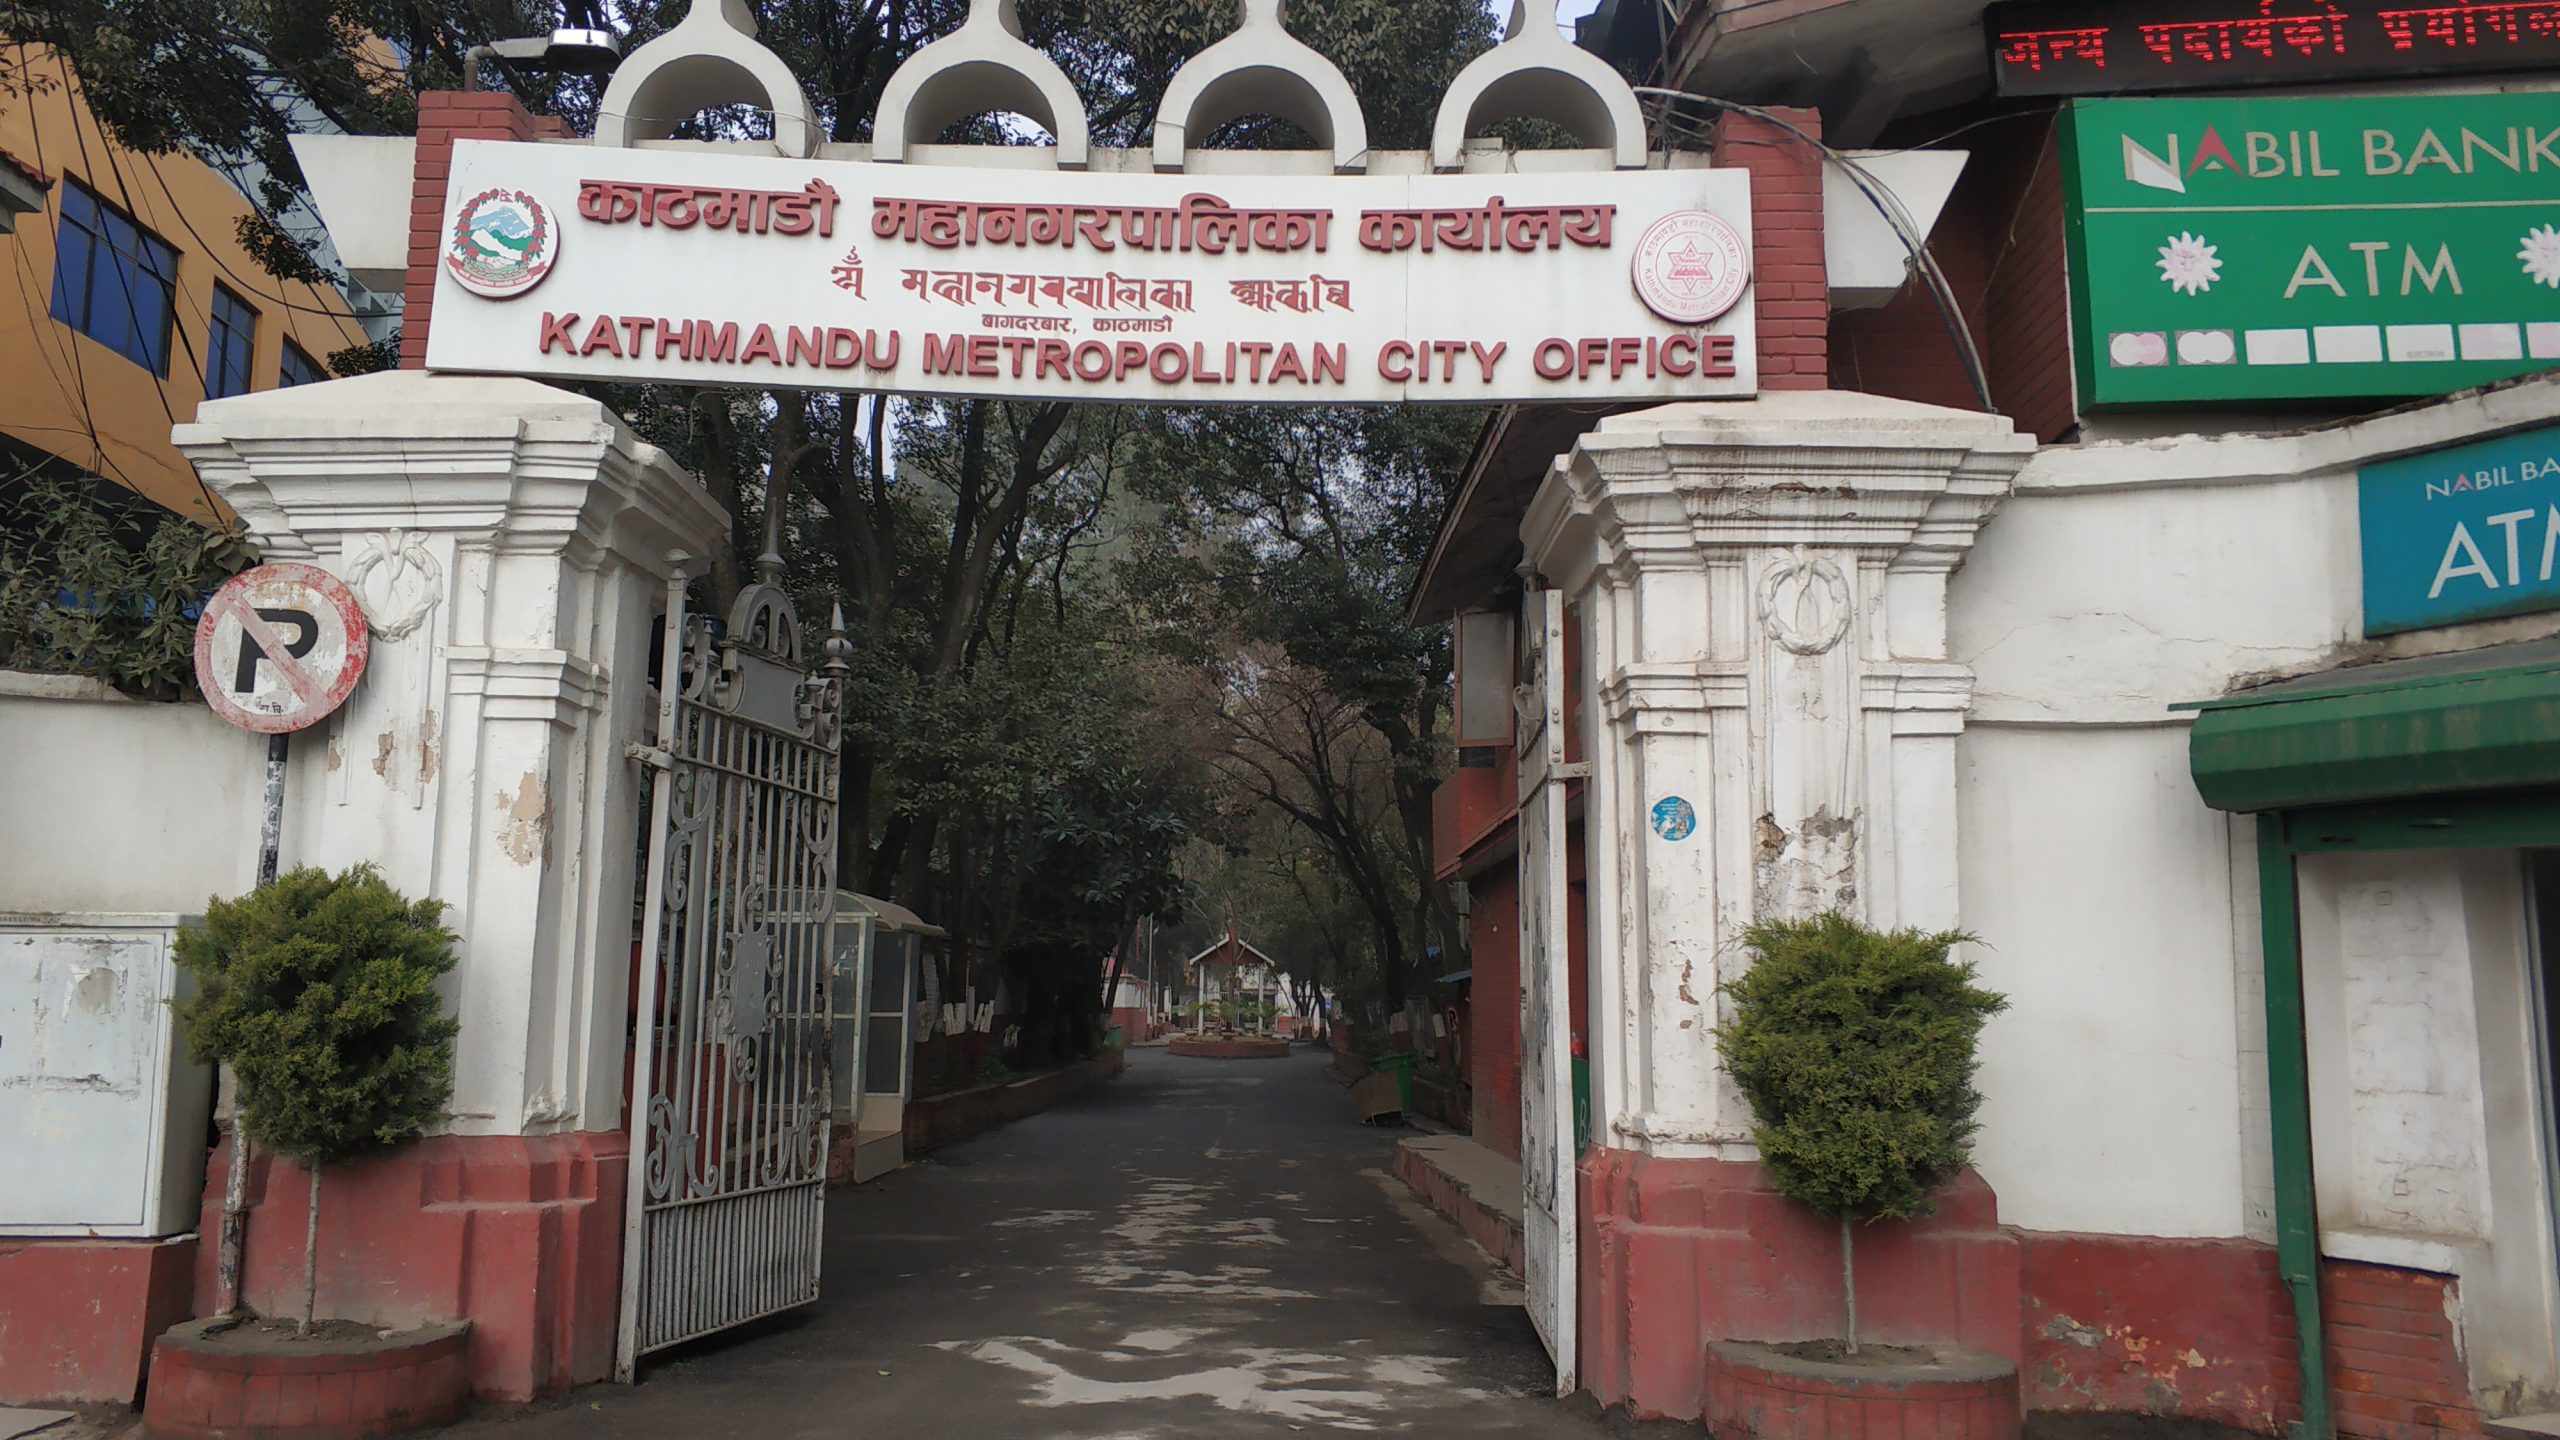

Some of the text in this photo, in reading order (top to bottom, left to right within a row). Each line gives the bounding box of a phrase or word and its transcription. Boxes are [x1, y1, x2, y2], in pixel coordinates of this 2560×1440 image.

[2121, 124, 2560, 193] NABIL BANK
[870, 192, 1333, 255] महानगरपालिका
[1358, 196, 1616, 253] कार्यालय
[2284, 242, 2463, 298] ATM
[539, 311, 1737, 386] KATHMANDU METROPOLITAN CITY OFFICE
[2425, 466, 2513, 501] NABIL
[236, 608, 319, 692] P
